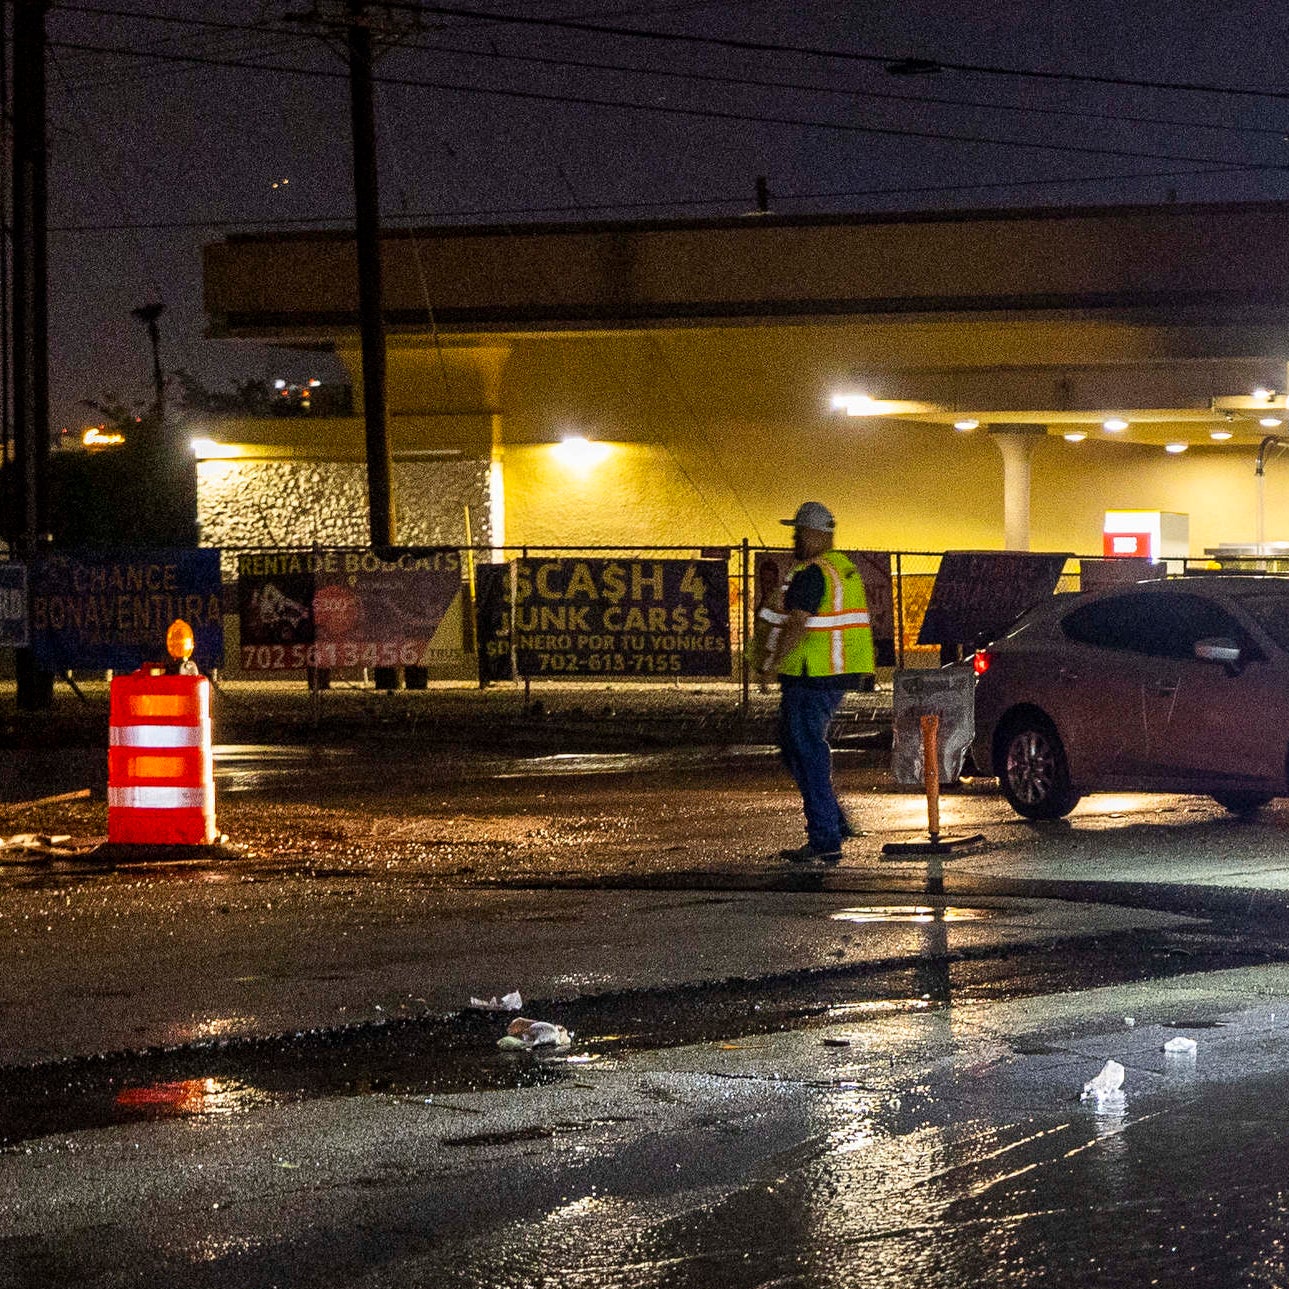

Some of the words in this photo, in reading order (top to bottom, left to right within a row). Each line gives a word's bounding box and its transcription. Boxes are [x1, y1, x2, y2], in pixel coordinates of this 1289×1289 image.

[240, 554, 302, 576] RENTA
[308, 552, 339, 573] DE
[679, 564, 706, 601] 4
[495, 606, 592, 637] JUNK
[578, 634, 615, 650] POR
[621, 634, 645, 650] TU
[242, 644, 285, 669] 702
